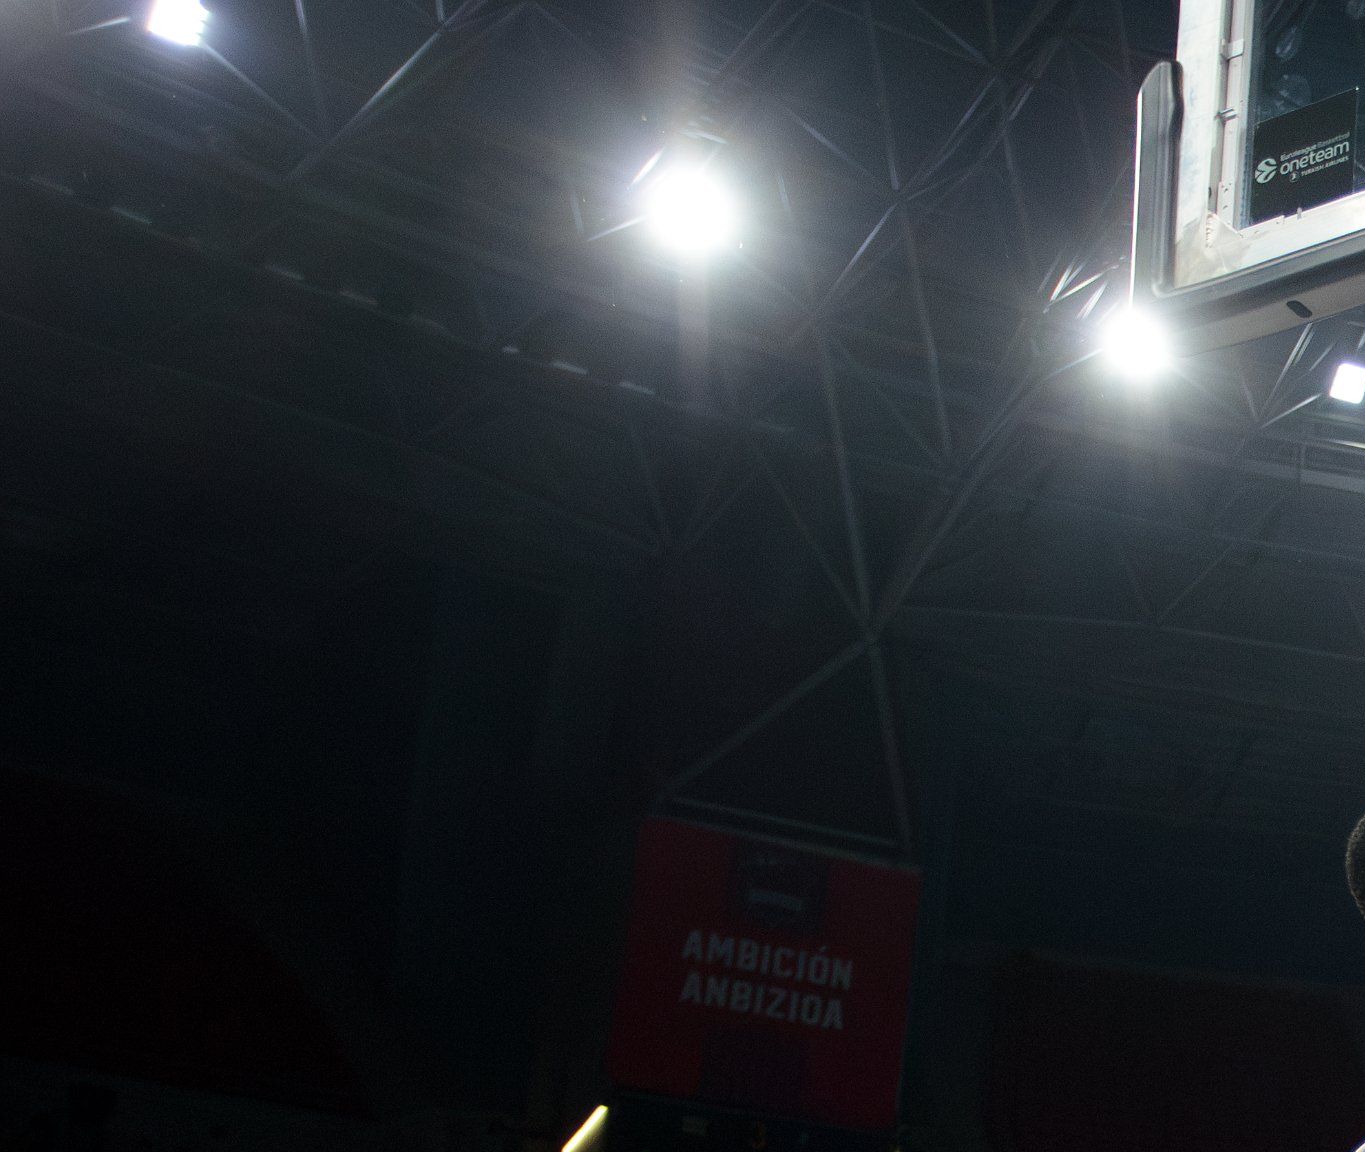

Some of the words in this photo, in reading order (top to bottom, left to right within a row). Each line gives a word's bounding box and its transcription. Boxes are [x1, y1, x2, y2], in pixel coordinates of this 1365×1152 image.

[1280, 141, 1349, 175] oneteam
[681, 928, 853, 991] AMBICIÓN
[678, 968, 845, 1030] ANBIZIOA
